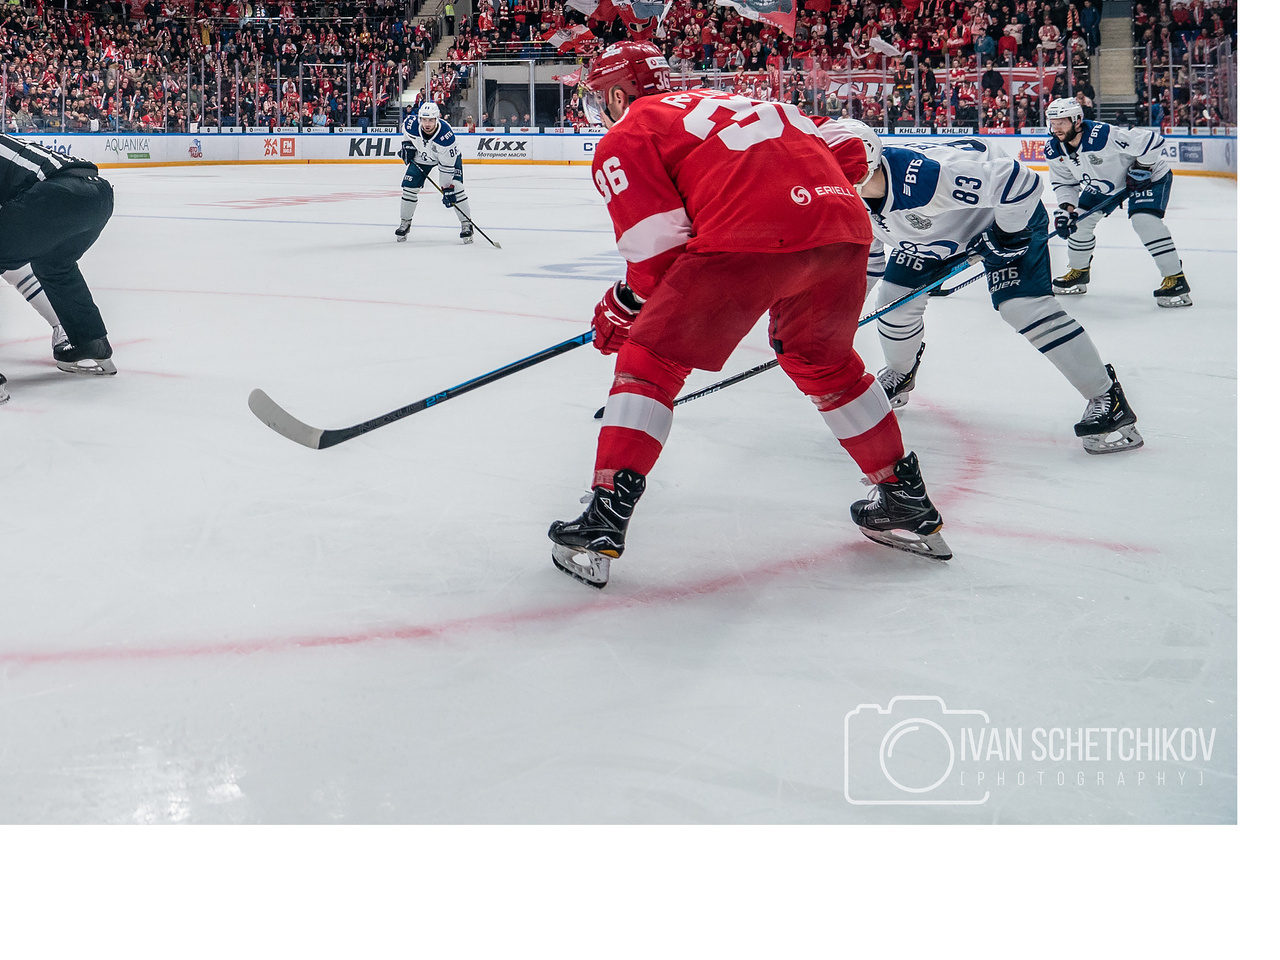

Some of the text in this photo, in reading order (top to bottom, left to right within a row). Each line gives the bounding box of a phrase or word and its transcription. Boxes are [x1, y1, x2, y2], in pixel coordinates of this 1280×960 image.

[653, 71, 671, 91] 36
[105, 138, 149, 153] AQUANIKA
[282, 141, 293, 149] FM
[349, 138, 396, 157] KHL
[477, 138, 528, 151] Kixx
[1115, 139, 1130, 150] 4
[595, 156, 630, 206] 36
[904, 159, 924, 186] ВТБ
[815, 185, 855, 197] ERIELL
[952, 176, 982, 206] 83
[895, 253, 925, 271] ВТБ
[991, 266, 1019, 285] ВТБ
